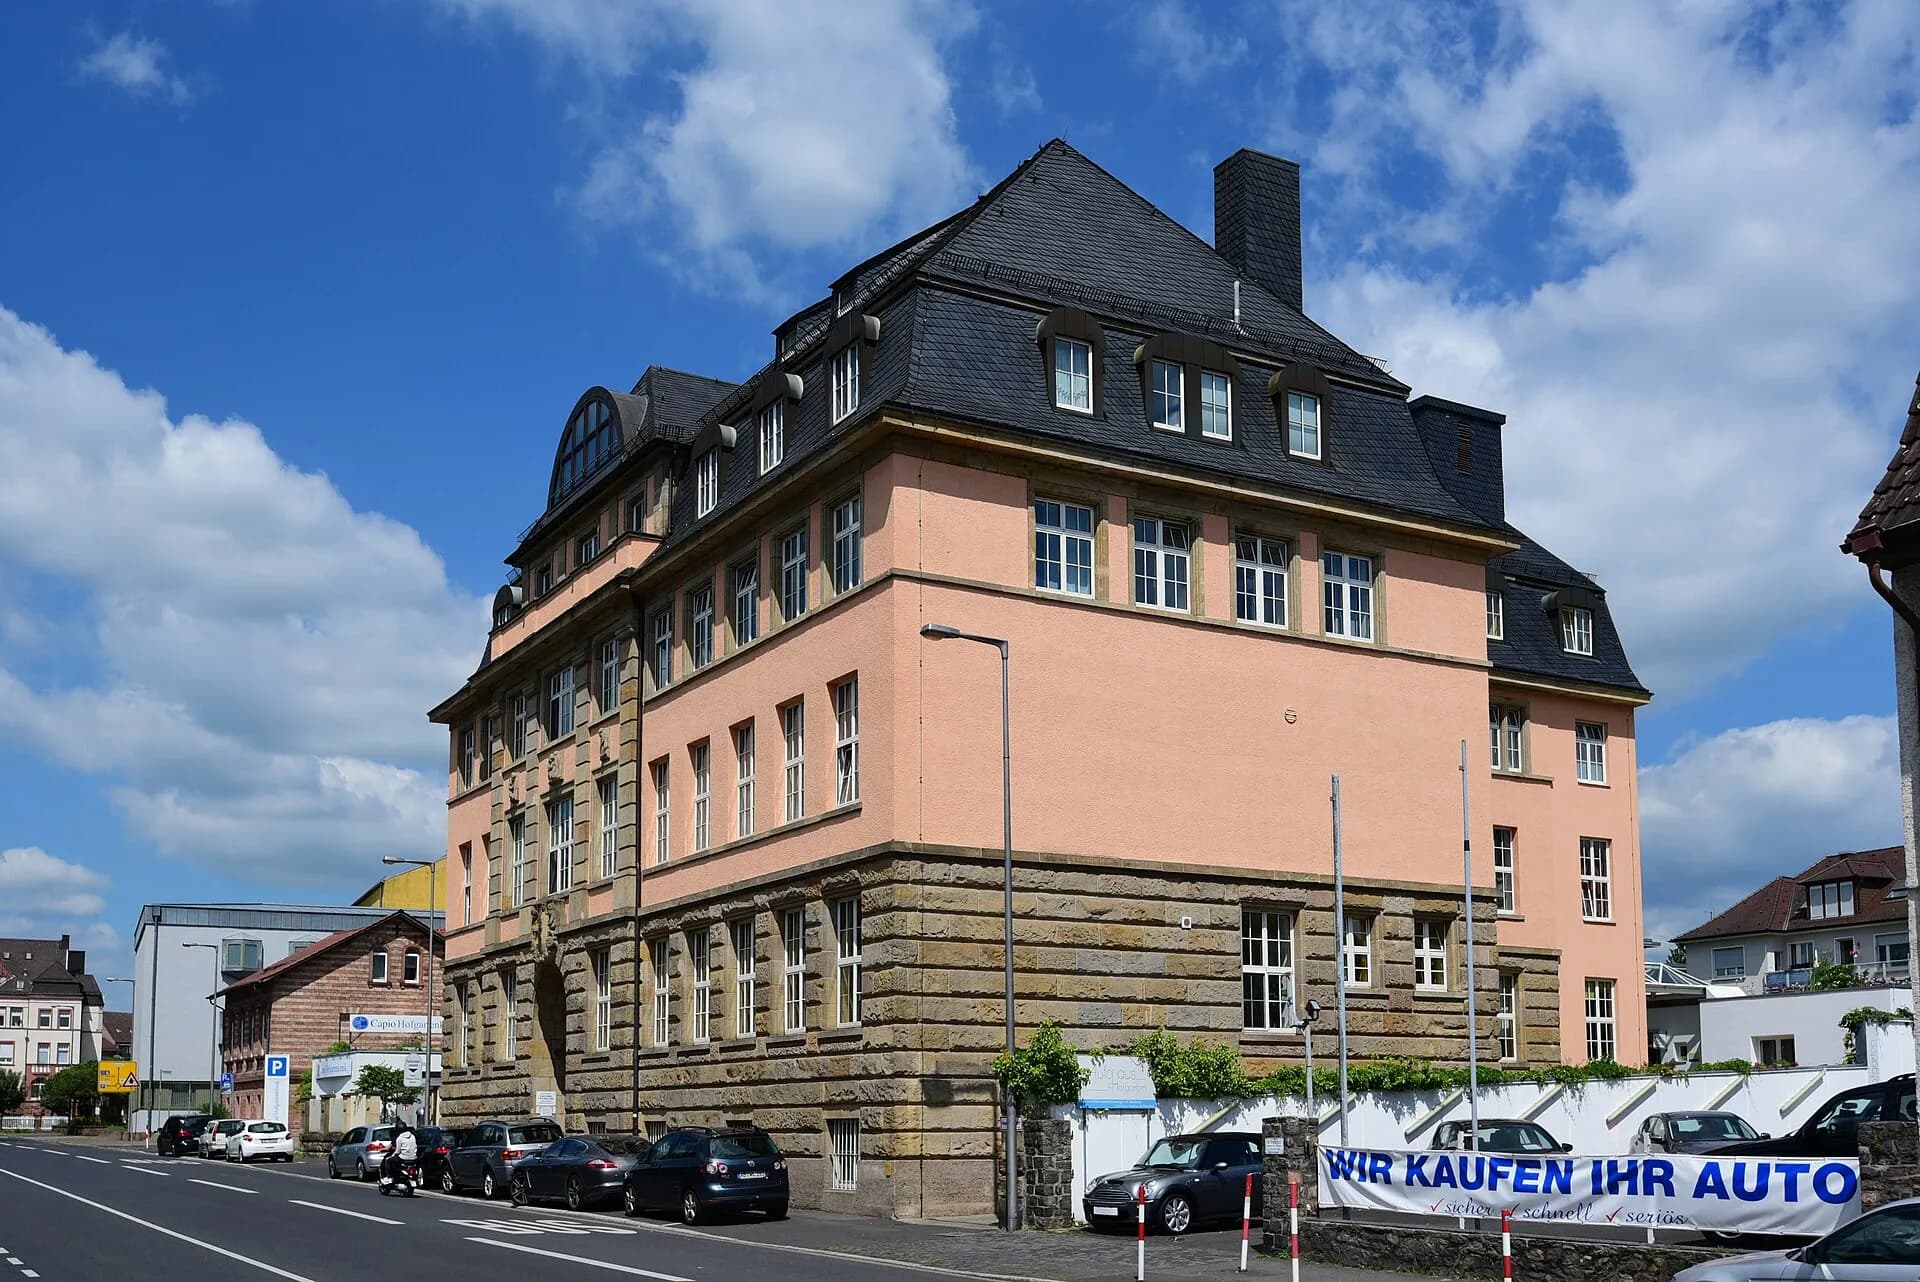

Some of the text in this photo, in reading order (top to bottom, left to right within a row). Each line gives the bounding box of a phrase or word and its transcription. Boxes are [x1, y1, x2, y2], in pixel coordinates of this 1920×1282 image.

[370, 1019, 443, 1030] Capio Hofgarenk
[272, 1060, 283, 1075] P
[1326, 1150, 1858, 1205] WIR KAUFEN IHR AUTO
[1444, 1198, 1689, 1225] sicher schnell seriös
[438, 1219, 638, 1235] BUS
